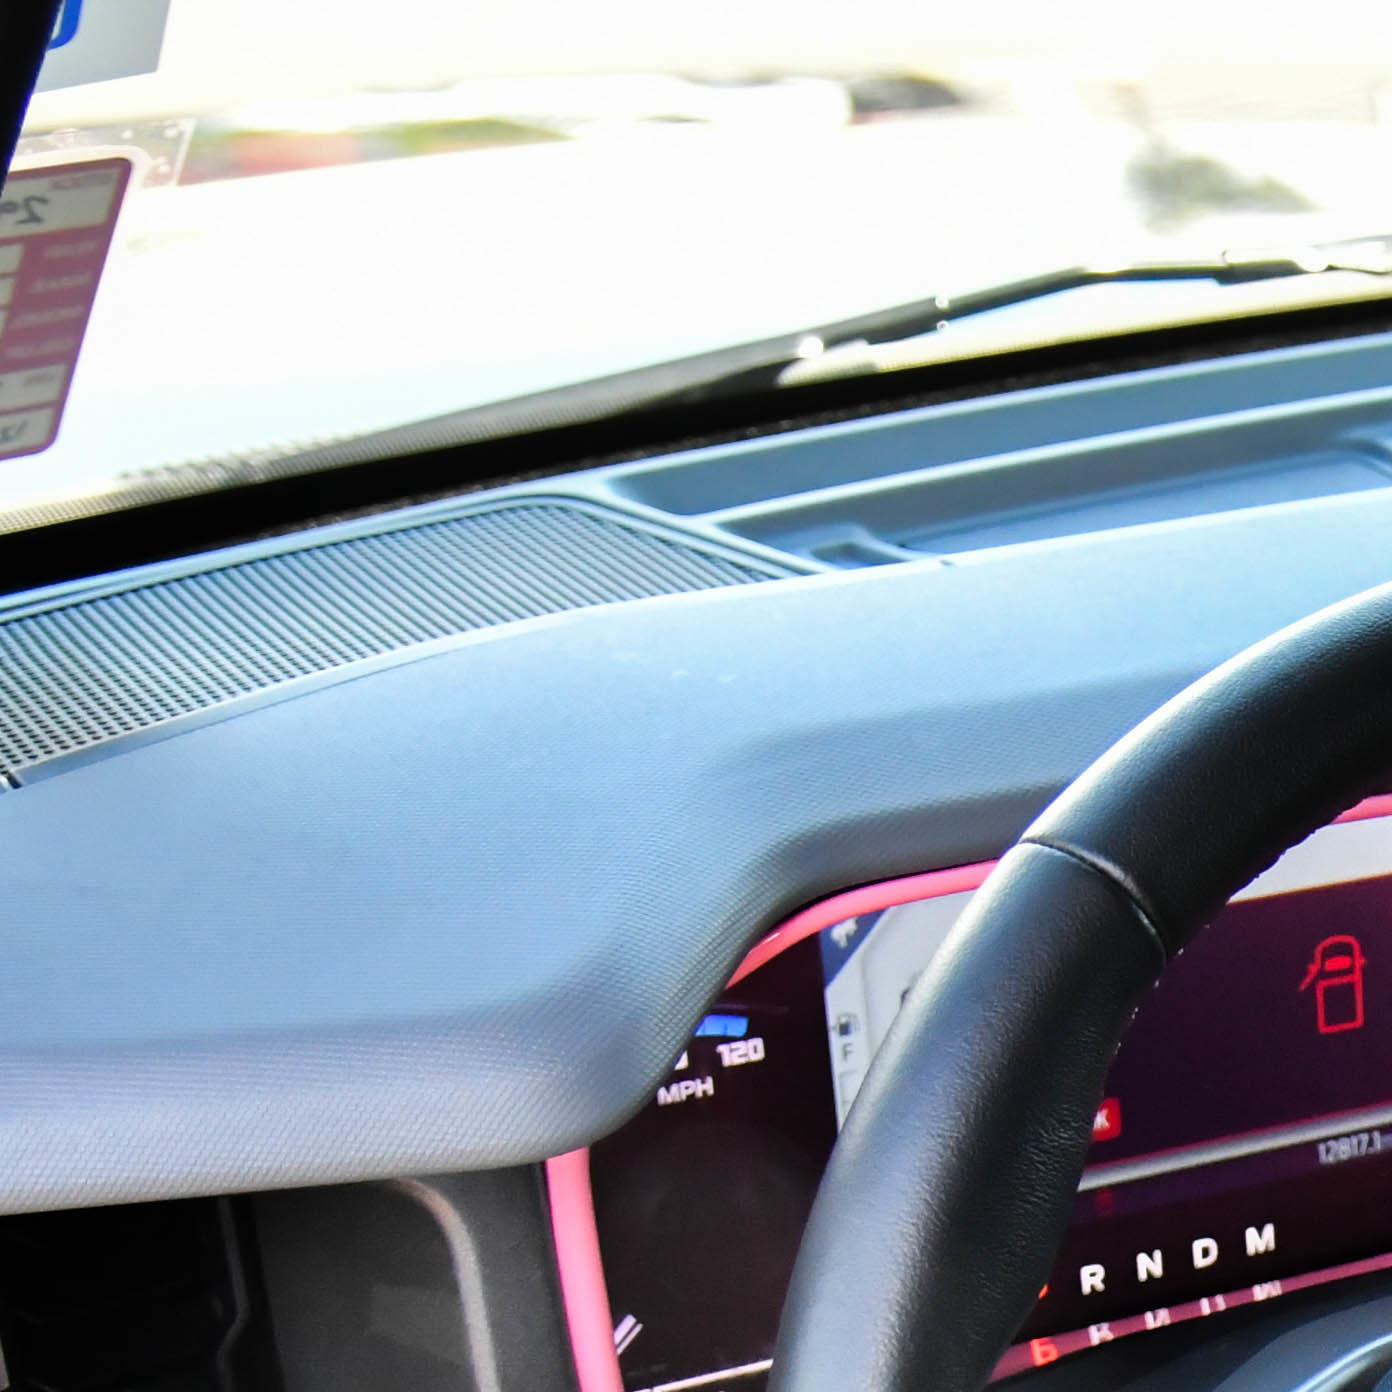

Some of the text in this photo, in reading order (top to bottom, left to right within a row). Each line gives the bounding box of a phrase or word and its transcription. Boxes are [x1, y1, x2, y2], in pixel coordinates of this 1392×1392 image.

[716, 1037, 766, 1068] 120
[657, 1076, 715, 1106] MPH
[1080, 1223, 1276, 1296] R N D M
